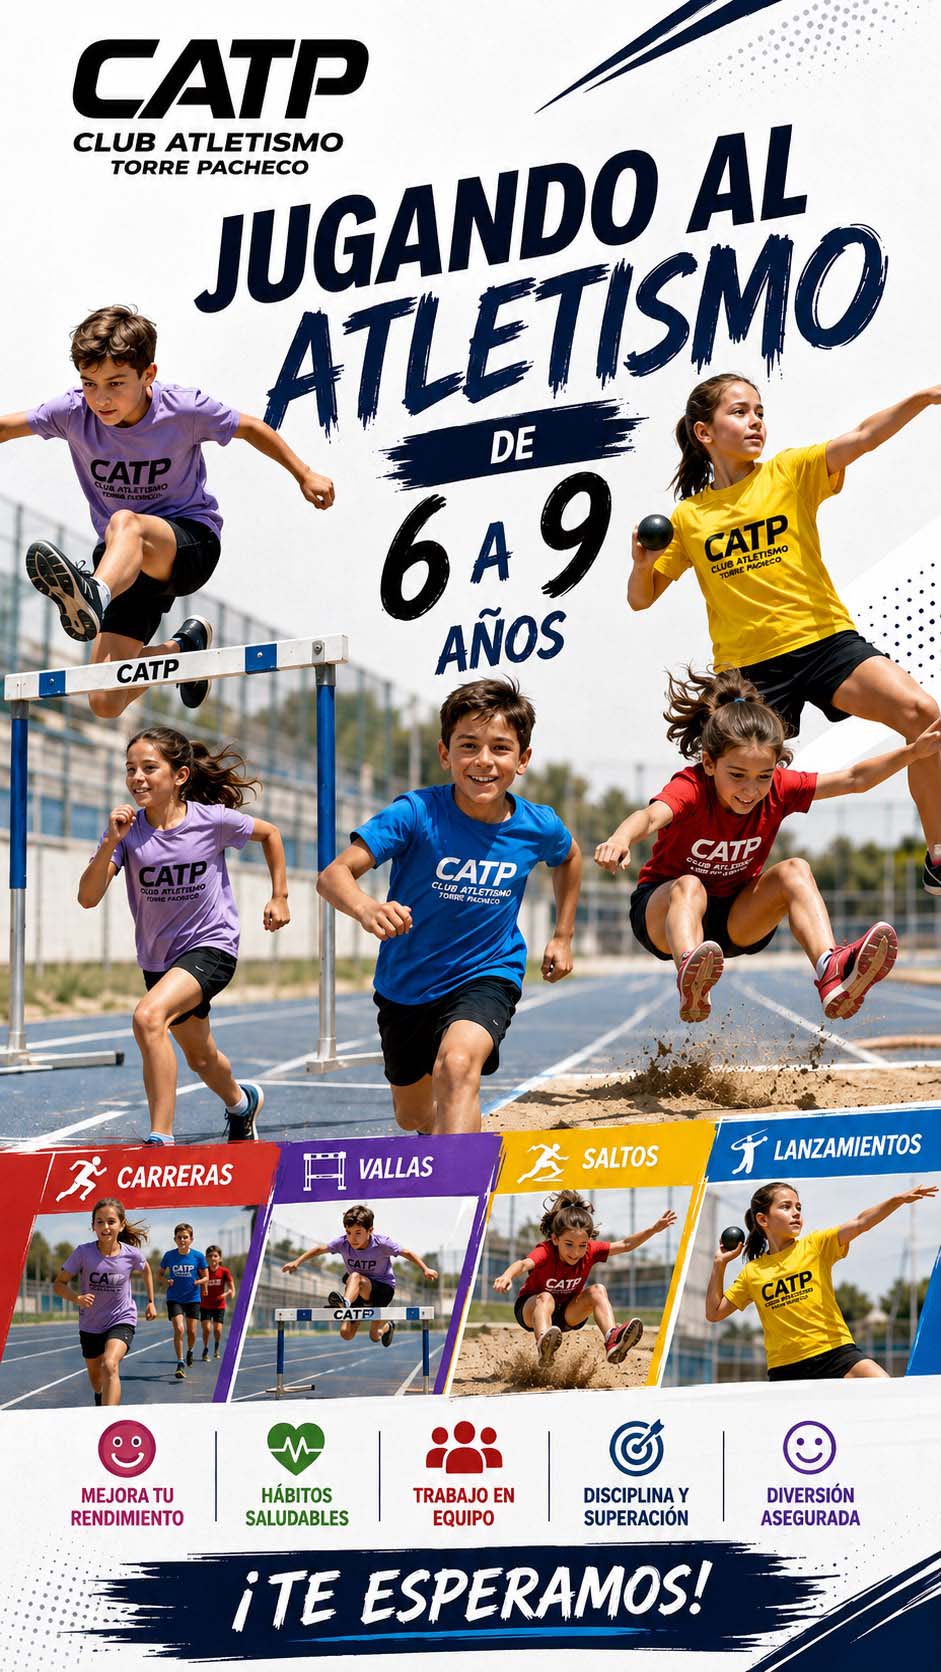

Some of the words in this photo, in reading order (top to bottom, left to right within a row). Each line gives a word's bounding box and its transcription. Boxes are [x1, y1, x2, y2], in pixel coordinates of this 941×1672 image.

[72, 39, 369, 119] CATP
[73, 132, 156, 152] CLUB
[164, 132, 344, 152] ATLETISMO
[111, 160, 190, 175] TORRE
[197, 160, 309, 175] PACHECO
[194, 149, 658, 314] JUGANDO
[686, 124, 808, 234] AL
[263, 223, 889, 443] ATLETISMO
[490, 425, 536, 464] DE
[91, 458, 172, 485] CATP
[380, 493, 450, 621] 6
[470, 521, 513, 584] A
[540, 471, 612, 599] 9
[704, 514, 788, 563] CATP
[711, 560, 734, 574] CLUB
[736, 545, 789, 565] ATLETISMO
[434, 607, 567, 675] AÑOS
[116, 658, 179, 684] CATP
[692, 836, 762, 862] CATP
[139, 861, 207, 887] CATP
[435, 857, 518, 887] CATP
[431, 881, 458, 893] CLUB
[460, 886, 512, 897] ATLETISMO
[582, 1145, 660, 1170] SALTOS
[774, 1133, 922, 1161] LANZAMIENTOS
[117, 1163, 234, 1190] CARRERAS
[358, 1156, 434, 1180] VALLAS
[347, 1259, 377, 1269] CATP
[546, 1277, 582, 1289] CATP
[761, 1270, 813, 1302] CATP
[81, 1488, 149, 1504] MEJORA
[154, 1488, 174, 1503] TU
[261, 1483, 332, 1503] HÁBITOS
[413, 1488, 489, 1504] TRABAJO
[494, 1488, 515, 1503] EN
[584, 1488, 674, 1503] DISCIPLINA
[677, 1488, 690, 1503] Y
[767, 1483, 855, 1504] DIVERSIÓN
[71, 1510, 184, 1526] RENDIMIENTO
[245, 1510, 349, 1526] SALUDABLES
[433, 1510, 495, 1528] EQUIPO
[584, 1505, 689, 1526] SUPERACIÓN
[761, 1510, 861, 1526] ASEGURADA
[231, 1570, 342, 1632] ¡TE
[360, 1560, 713, 1625] ESPERAMOS!
